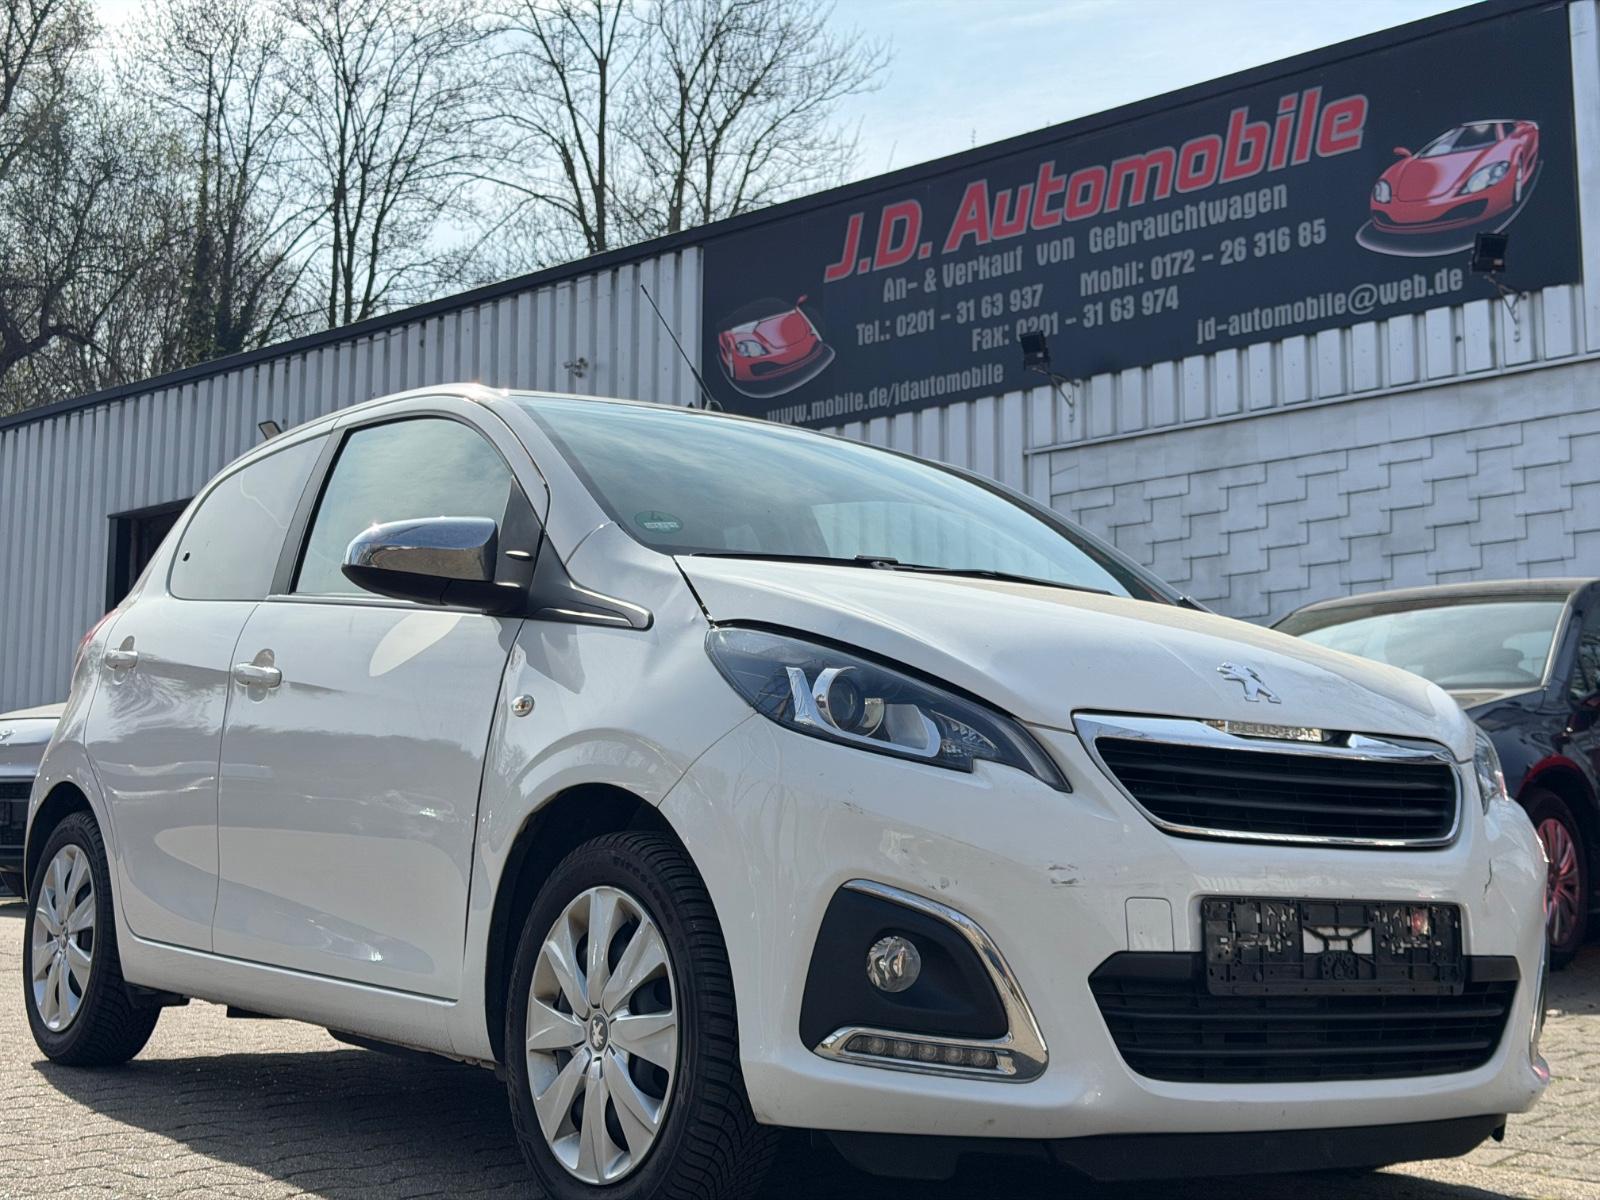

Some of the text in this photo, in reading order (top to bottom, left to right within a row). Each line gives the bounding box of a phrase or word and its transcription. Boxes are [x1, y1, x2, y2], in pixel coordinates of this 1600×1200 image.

[824, 86, 1368, 284] J.D. Automobile
[883, 184, 1288, 303] An- & Verkauf von Gebrauchtwagen
[1080, 260, 1144, 297] Mobil:
[1151, 249, 1195, 281] 0172
[1220, 236, 1247, 266] 26
[1253, 226, 1291, 258] 316
[1298, 218, 1327, 248] 85
[856, 319, 891, 346] Tel.:
[896, 308, 935, 338] 0201
[956, 299, 975, 325] 31
[981, 292, 1004, 319] 63
[1010, 283, 1044, 313] 937
[971, 323, 1010, 352] Fax:
[1083, 301, 1104, 329] 31
[1110, 295, 1135, 323] 63
[1142, 285, 1180, 316] 974
[1196, 267, 1464, 345] jd-automobile@web.de
[767, 363, 1004, 426] www.mobile.de/jdautomobile
